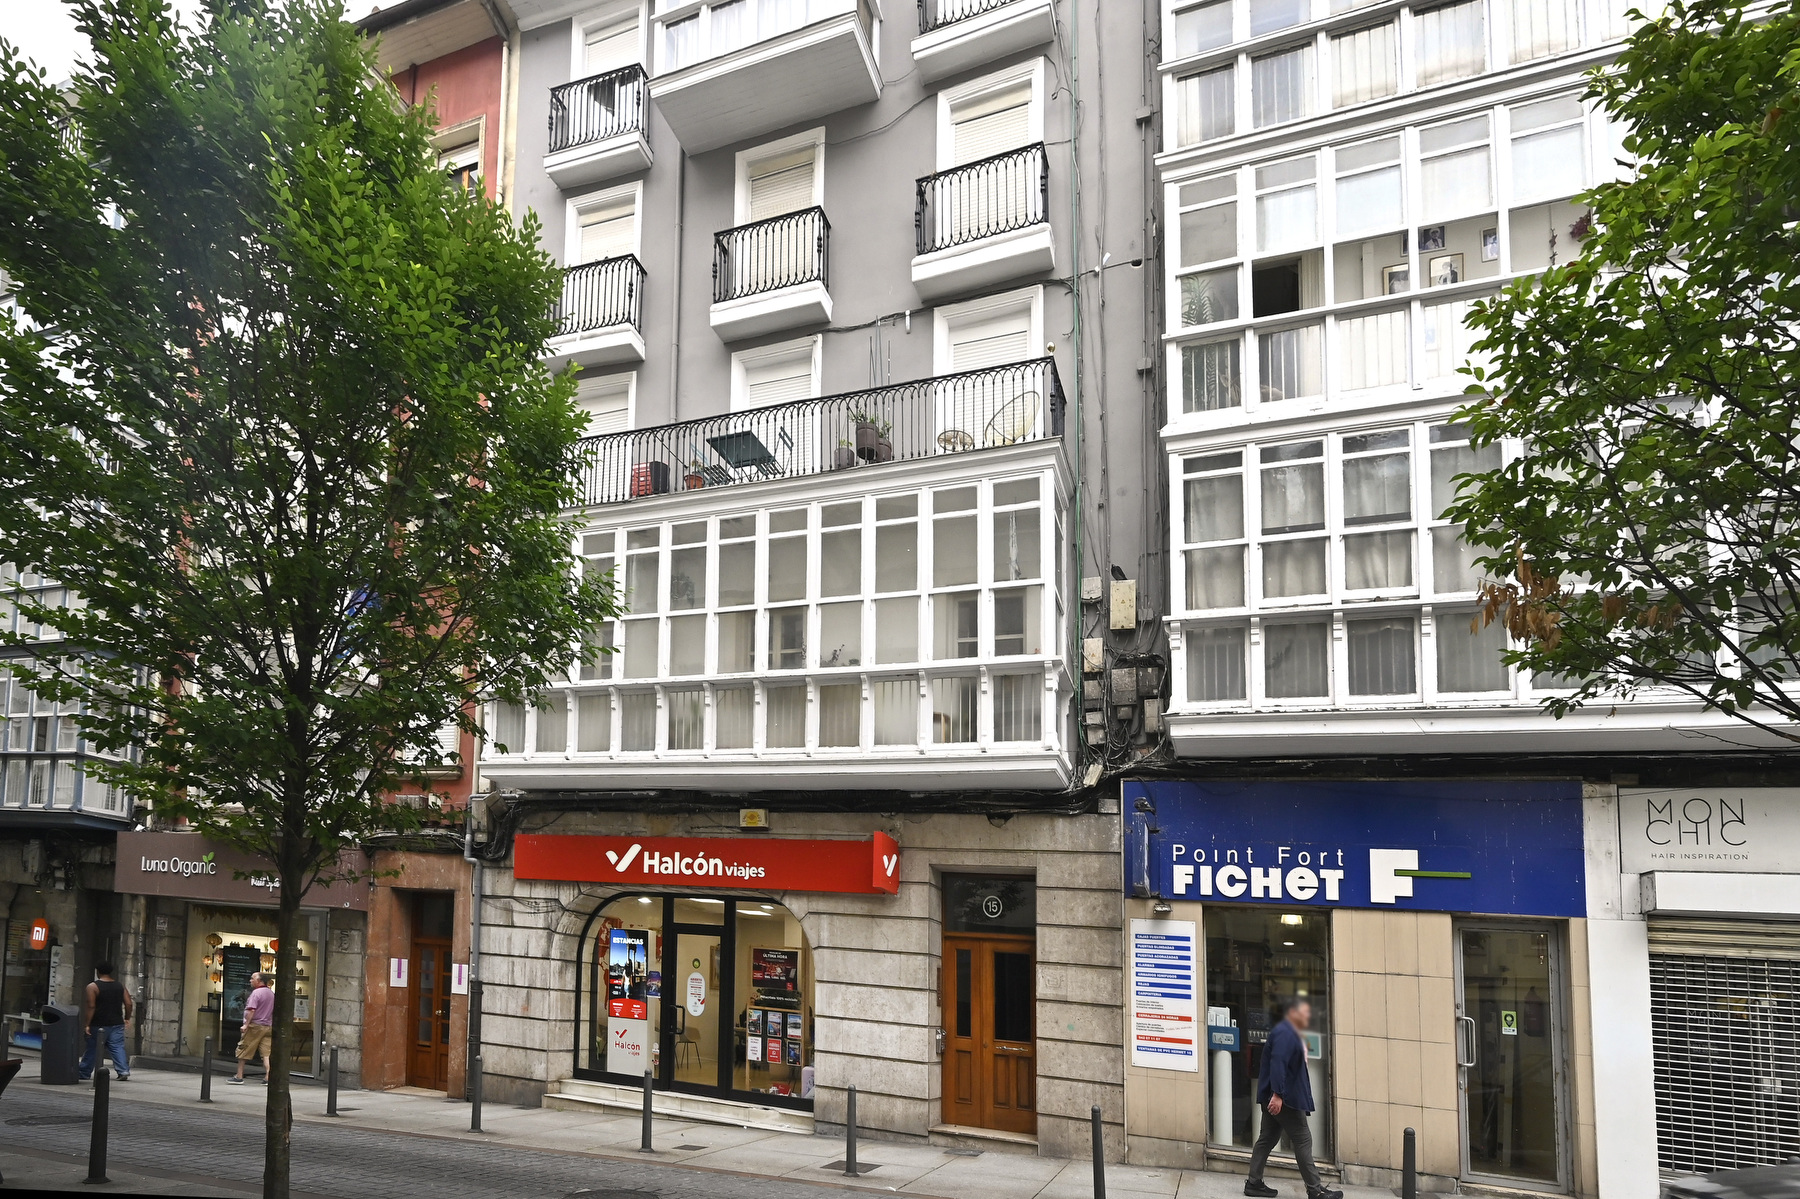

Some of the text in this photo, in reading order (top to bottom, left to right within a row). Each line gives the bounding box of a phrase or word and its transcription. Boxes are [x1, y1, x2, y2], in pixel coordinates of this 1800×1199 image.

[1647, 798, 1745, 826] MON
[1646, 819, 1747, 846] CHIC
[141, 856, 217, 877] Luna Organic
[643, 851, 766, 880] Halcón viajes
[1172, 844, 1344, 867] Point Fort
[987, 901, 998, 912] 15
[612, 937, 644, 945] ESTANCIAS
[614, 1040, 640, 1051] Halcón
